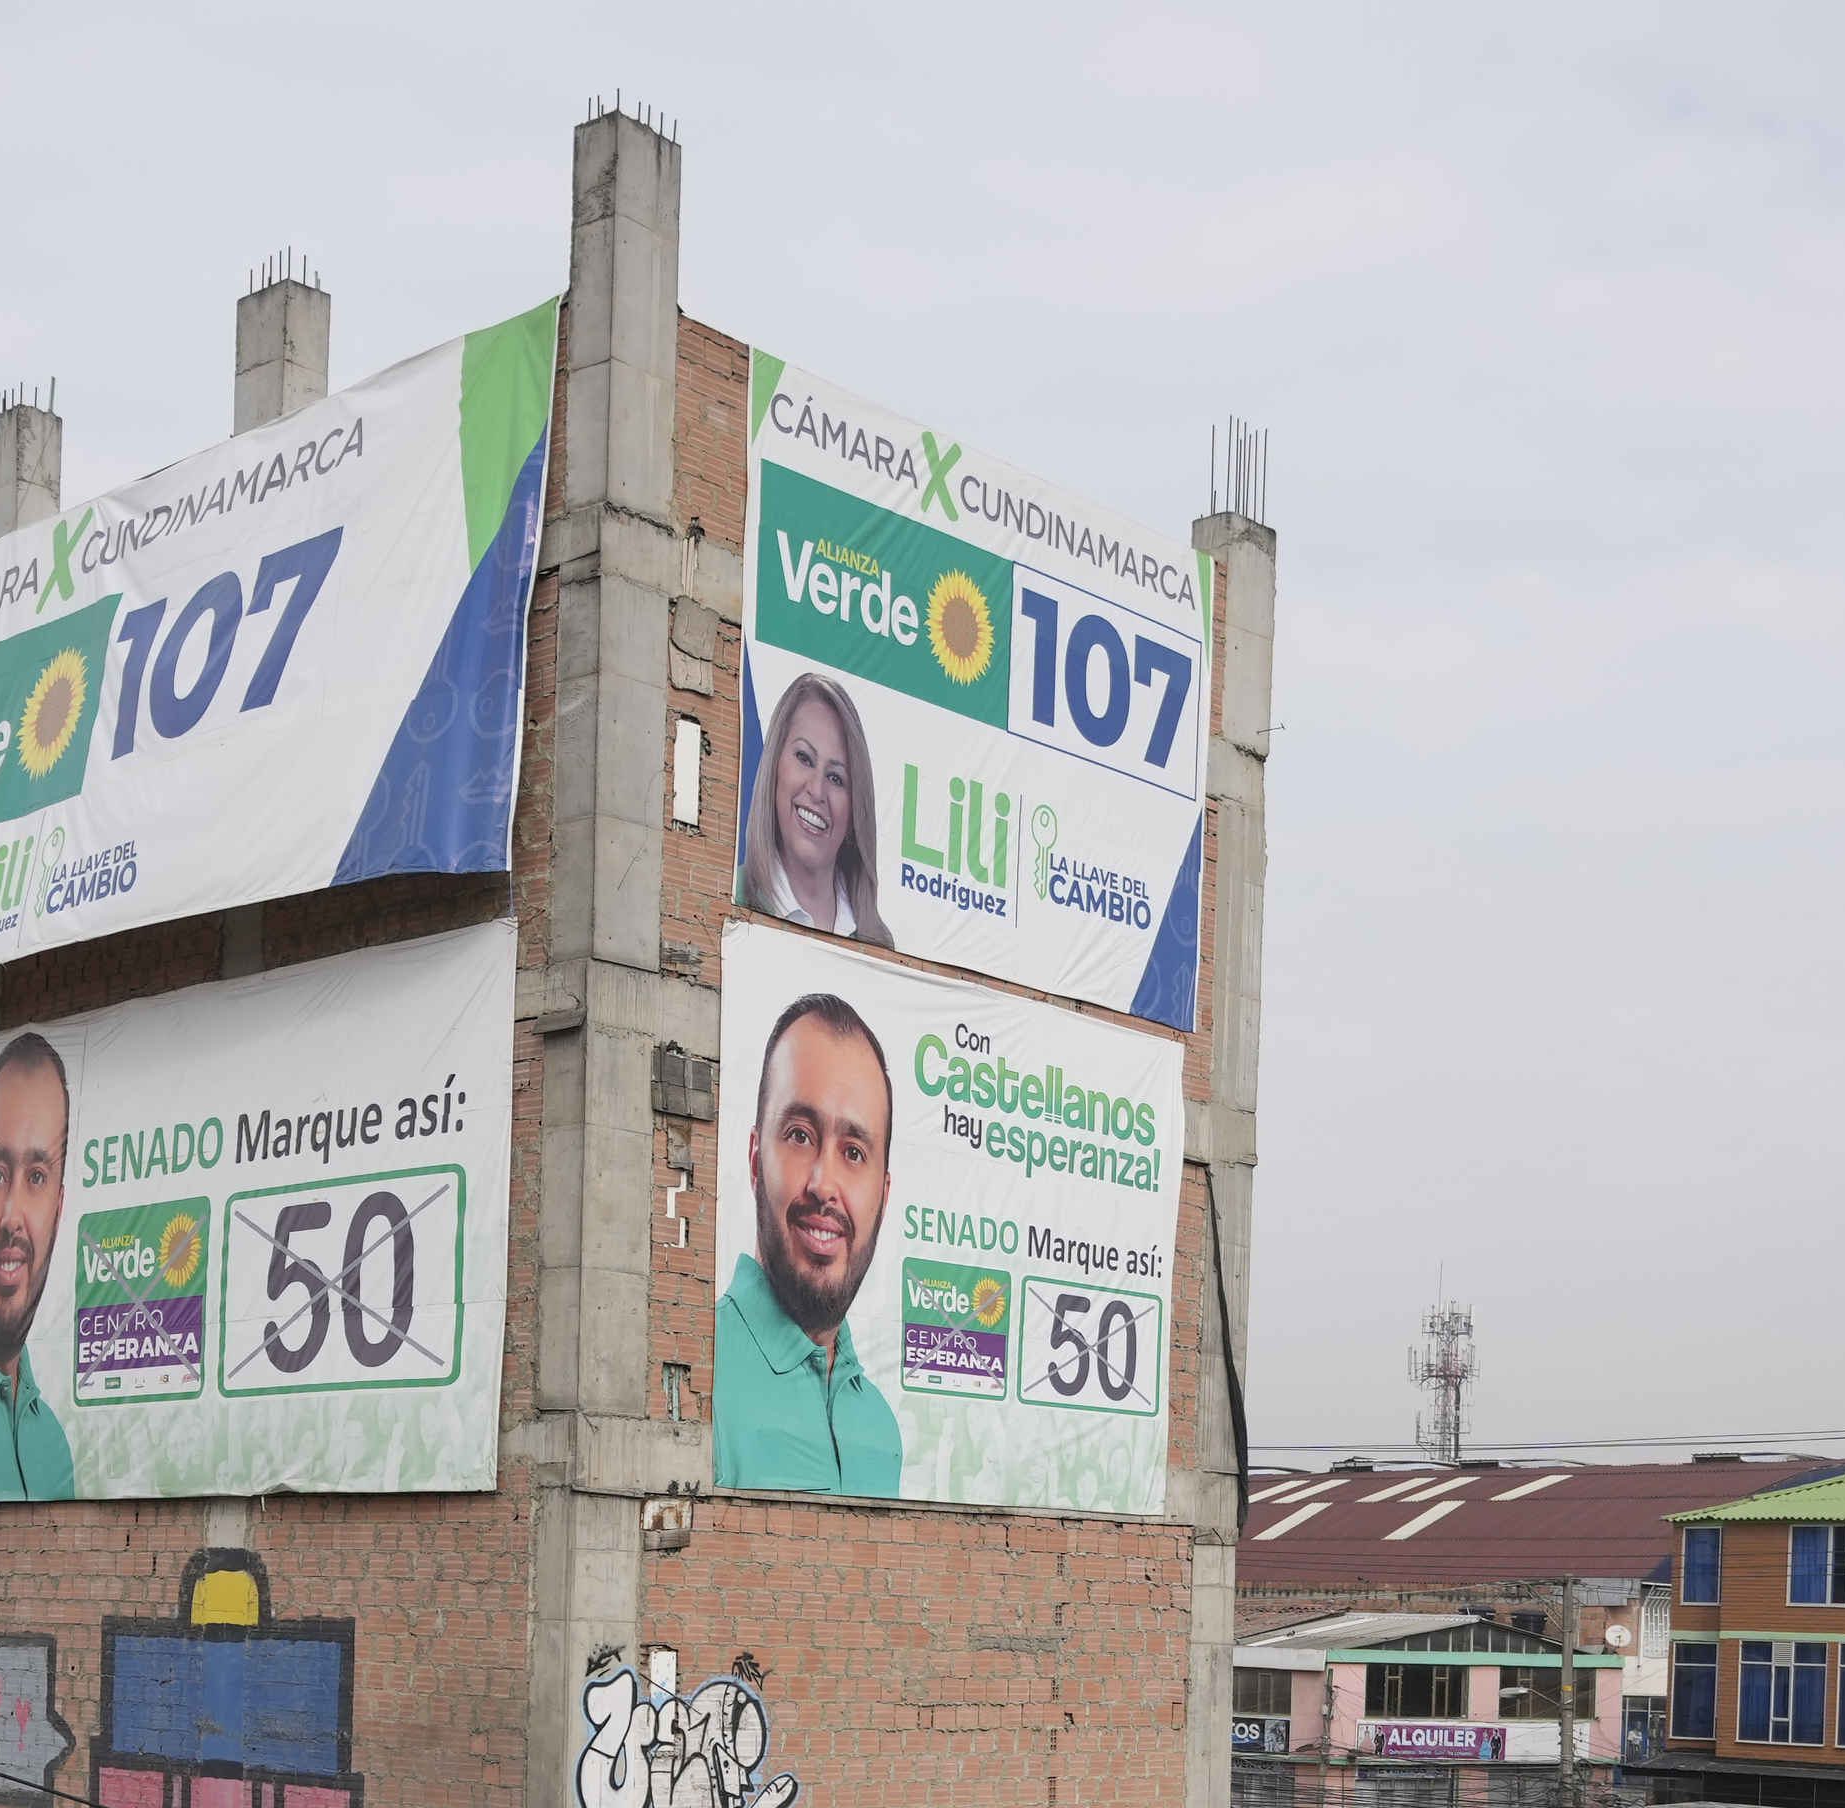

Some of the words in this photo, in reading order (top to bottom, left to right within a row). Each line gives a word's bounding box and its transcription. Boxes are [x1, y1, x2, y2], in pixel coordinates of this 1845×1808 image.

[35, 507, 93, 615] X
[81, 418, 363, 574] CUNDINAMARCA
[770, 394, 918, 490] CÁMARA
[921, 431, 962, 521] X
[960, 476, 1195, 610] CUNDINAMARCA
[815, 538, 880, 579] ALIANZA
[776, 530, 919, 646] Verde
[110, 525, 344, 761] 107
[1021, 587, 1192, 769] 107
[901, 763, 1010, 889] Lili
[45, 860, 137, 914] CAMBIO
[51, 866, 67, 884] LA
[70, 850, 111, 878] LLAVE
[113, 840, 137, 865] DEL
[1050, 853, 1069, 875] LA
[1072, 859, 1119, 890] LLAVE
[1122, 875, 1149, 900] DEL
[901, 863, 1006, 917] Rodríguez
[1049, 874, 1151, 930] CAMBIO
[955, 1023, 990, 1054] Con
[914, 1034, 1156, 1146] Castellanos
[82, 1117, 224, 1188] SENADO
[235, 1103, 382, 1164] Marque
[394, 1074, 467, 1141] así:
[943, 1104, 983, 1149] hay
[985, 1121, 1161, 1193] esperanza!
[82, 1239, 155, 1284] Verde
[100, 1234, 135, 1251] ALIANZA
[904, 1204, 1019, 1254] SENADO
[1027, 1225, 1119, 1275] Marque
[1126, 1244, 1163, 1278] así:
[263, 1191, 414, 1373] 50
[907, 1279, 970, 1314] Verde
[923, 1278, 952, 1290] ALIANZA
[78, 1332, 199, 1364] ESPERANZA
[79, 1308, 164, 1337] CENTRO
[906, 1329, 977, 1351] CENTRO
[1048, 1293, 1137, 1401] 50
[905, 1346, 1004, 1372] ESPERANZA
[1388, 1728, 1477, 1747] ALQUILER
